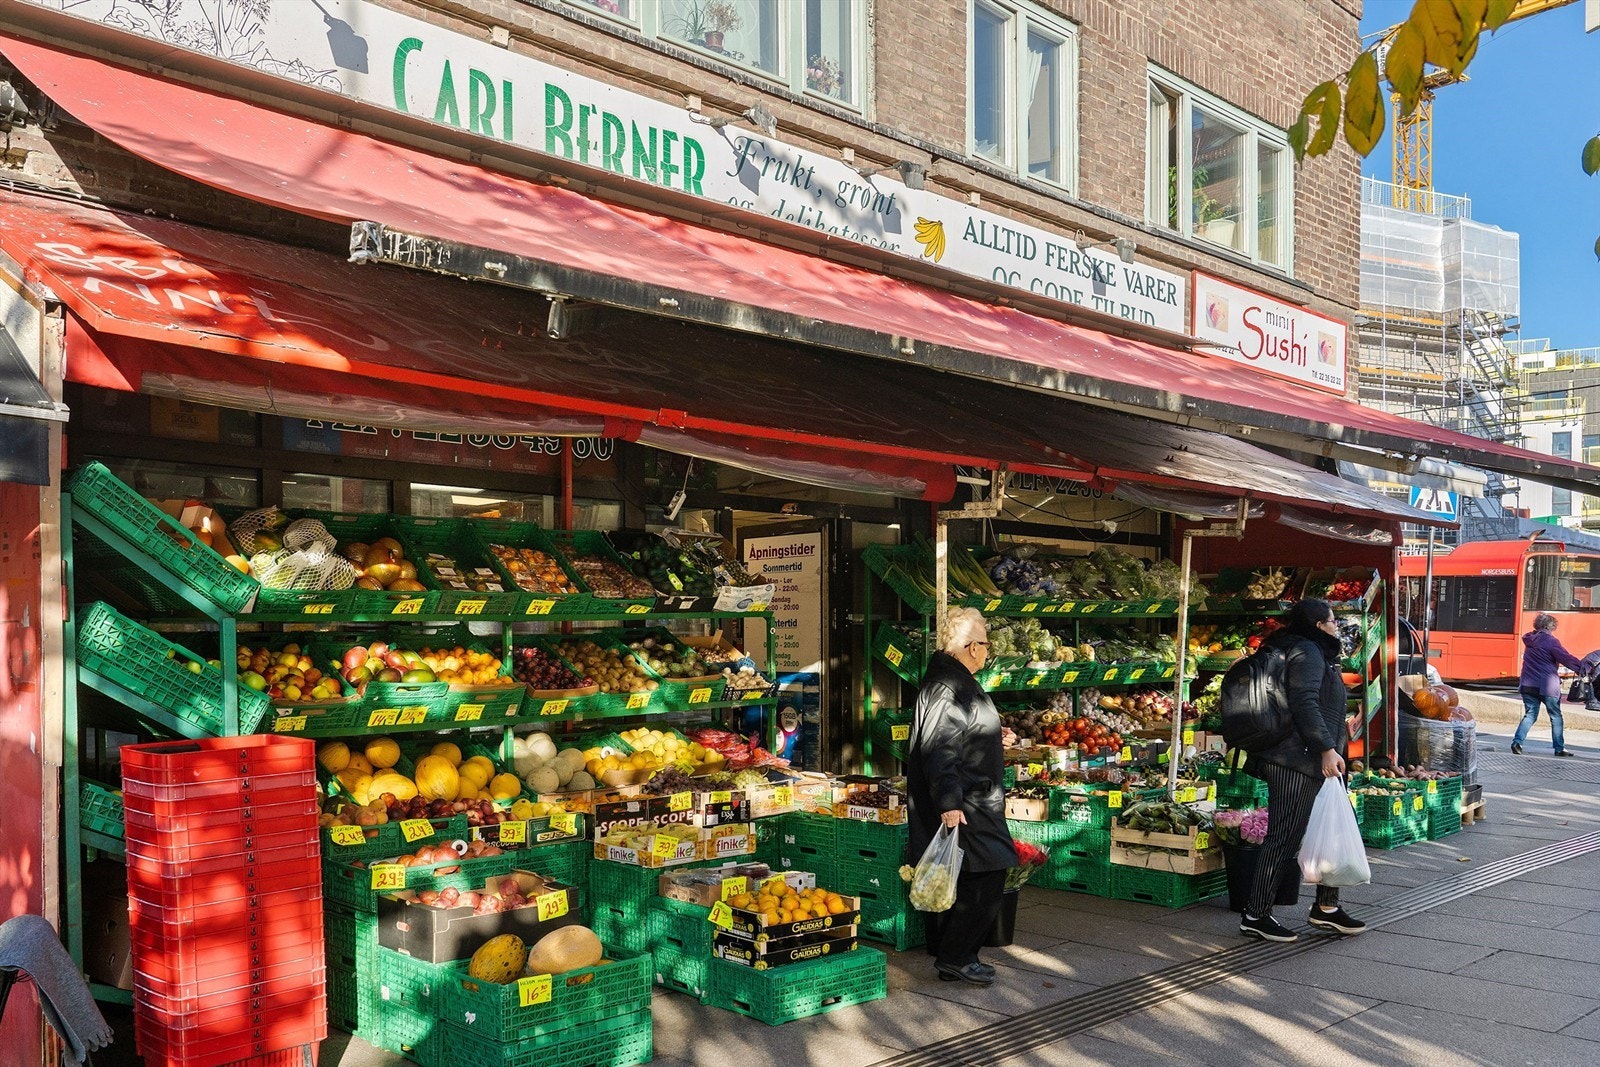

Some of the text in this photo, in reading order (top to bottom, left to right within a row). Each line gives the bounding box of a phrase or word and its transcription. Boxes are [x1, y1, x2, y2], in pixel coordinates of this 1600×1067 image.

[544, 82, 706, 197] BERNER
[726, 135, 896, 215] Frukt, grønt
[963, 217, 1178, 307] ALLTID FERSKE VARER
[1266, 306, 1289, 330] mini
[1238, 306, 1308, 367] Sushi
[749, 543, 815, 561] Åpningstider
[763, 562, 802, 573] Sommertid
[1481, 568, 1515, 576] NORGESBUSS
[653, 809, 695, 825] SCOPE
[338, 832, 358, 844] 24
[408, 825, 427, 840] 24
[376, 872, 397, 888] 29
[545, 900, 560, 919] 29
[792, 920, 823, 933] GAUDIAS
[790, 947, 821, 960] GAUDIAS
[526, 985, 539, 1005] 16
